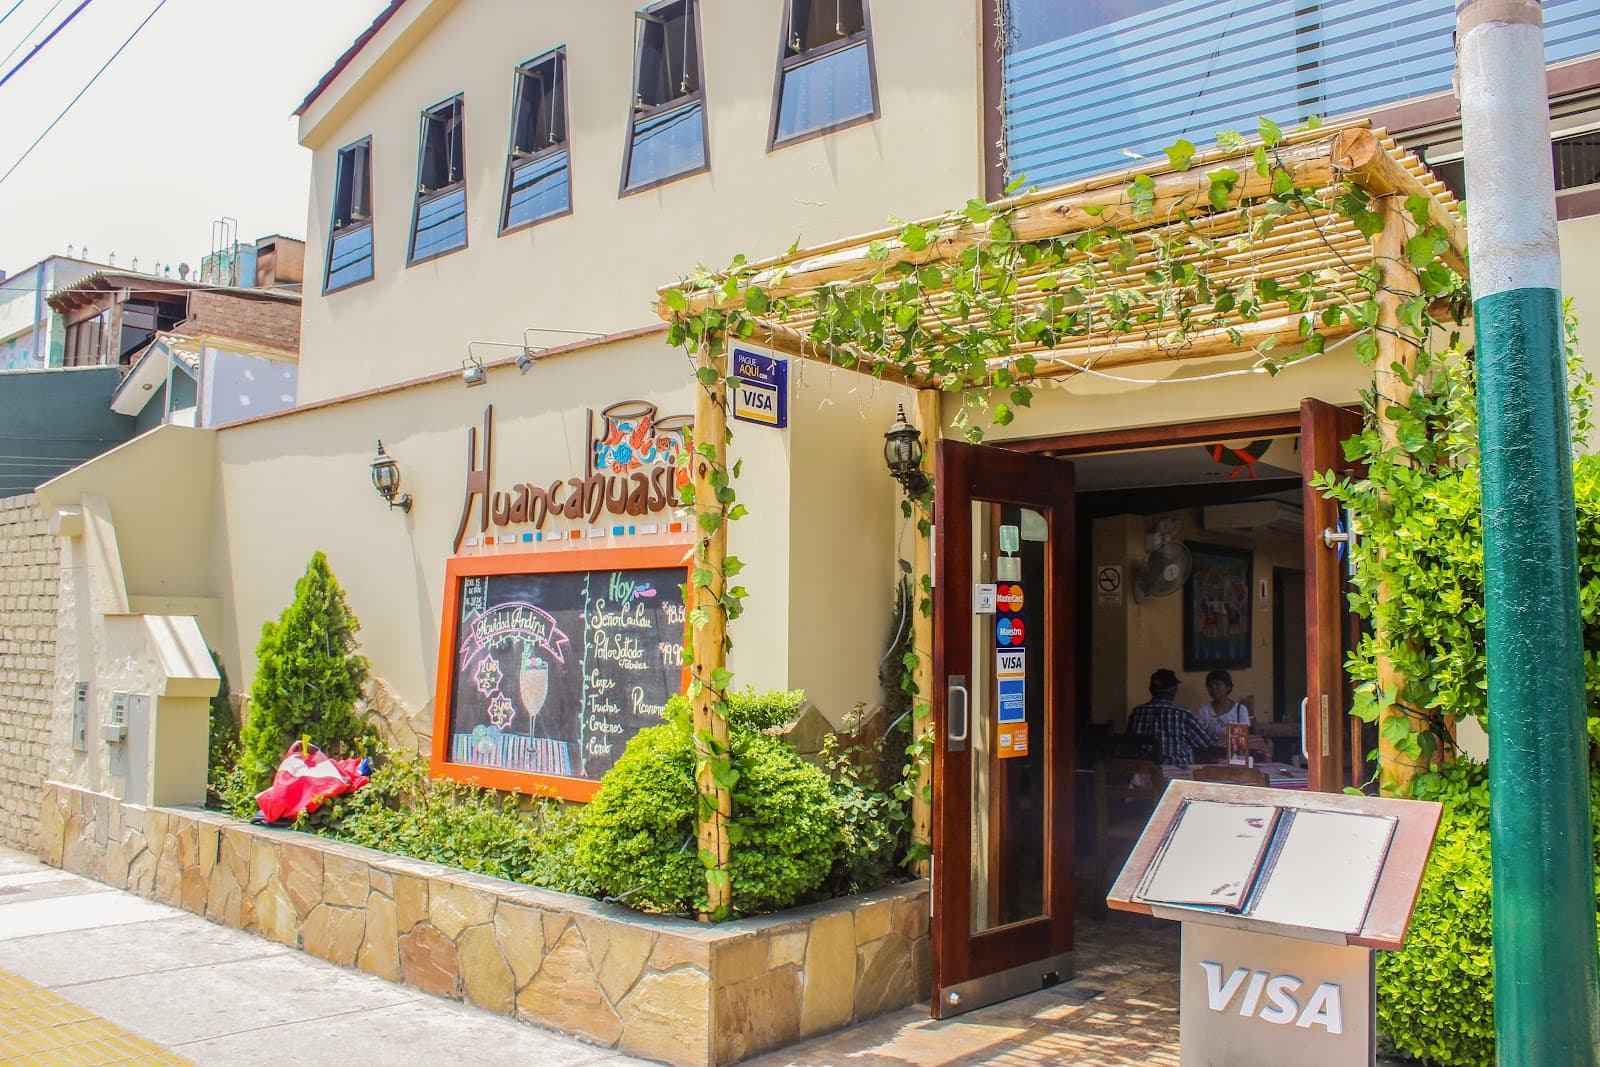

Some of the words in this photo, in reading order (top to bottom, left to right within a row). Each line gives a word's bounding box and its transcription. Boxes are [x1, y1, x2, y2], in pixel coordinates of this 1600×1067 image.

[738, 354, 757, 366] PAGUE
[742, 389, 772, 411] VISA
[453, 404, 680, 554] Huancahuasi
[609, 571, 635, 605] Hoy
[476, 611, 510, 639] Navidad
[511, 605, 545, 636] Andina
[1000, 628, 1021, 636] Maestro
[1001, 656, 1021, 669] VISA
[632, 686, 665, 717] Picarone
[1200, 961, 1343, 1034] VISA
